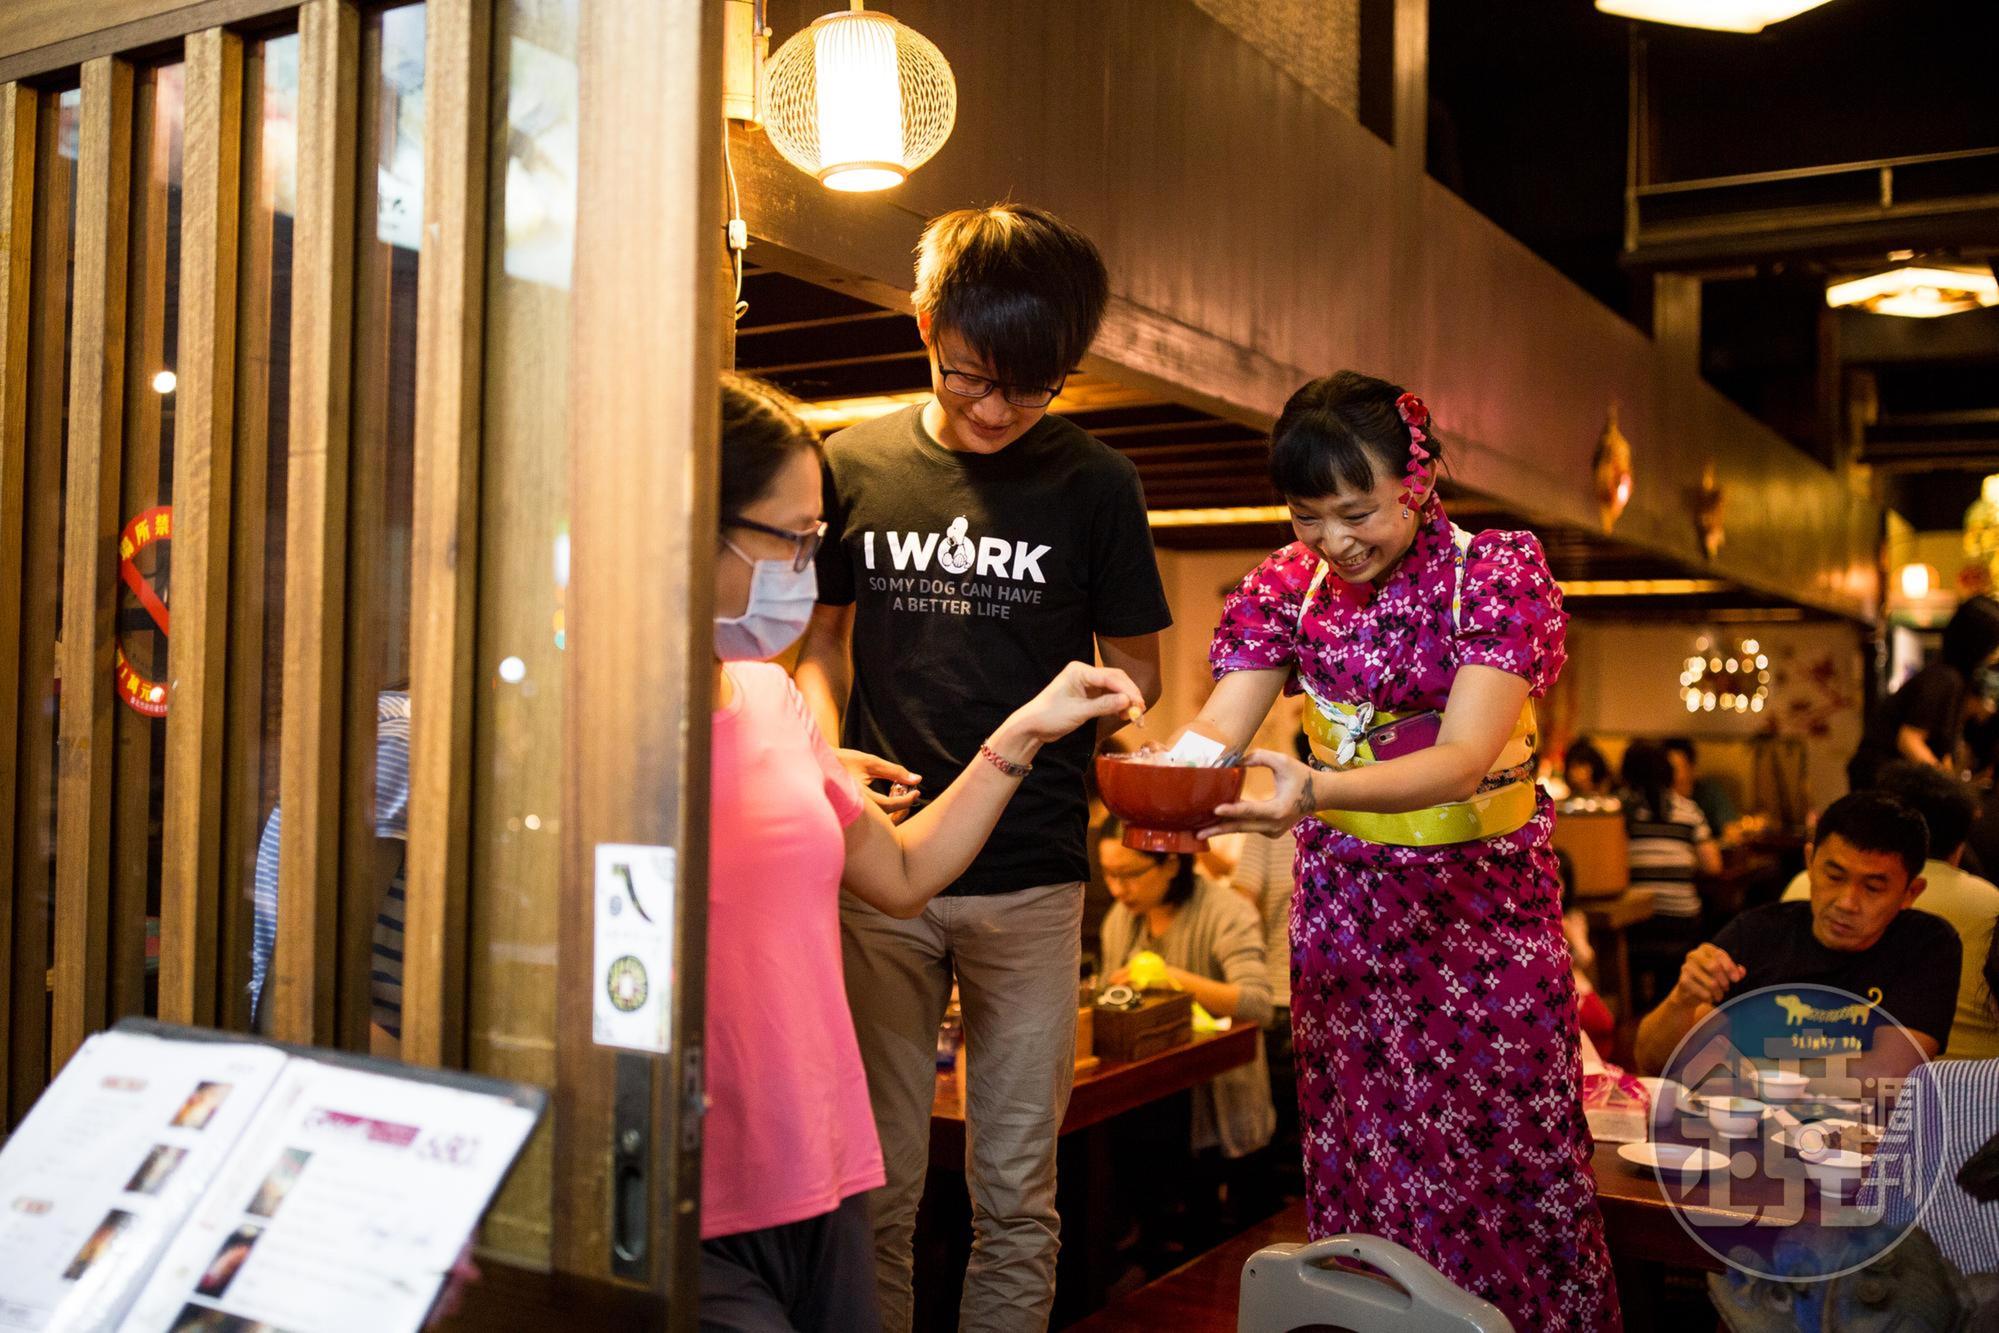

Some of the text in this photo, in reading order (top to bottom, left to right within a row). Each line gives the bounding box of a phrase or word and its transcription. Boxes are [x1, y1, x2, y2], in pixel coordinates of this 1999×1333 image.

[864, 531, 1052, 583] I WORK
[869, 577, 1042, 605] SO MY DOG CAN HAVE
[893, 597, 1011, 620] A BETTER LIFE
